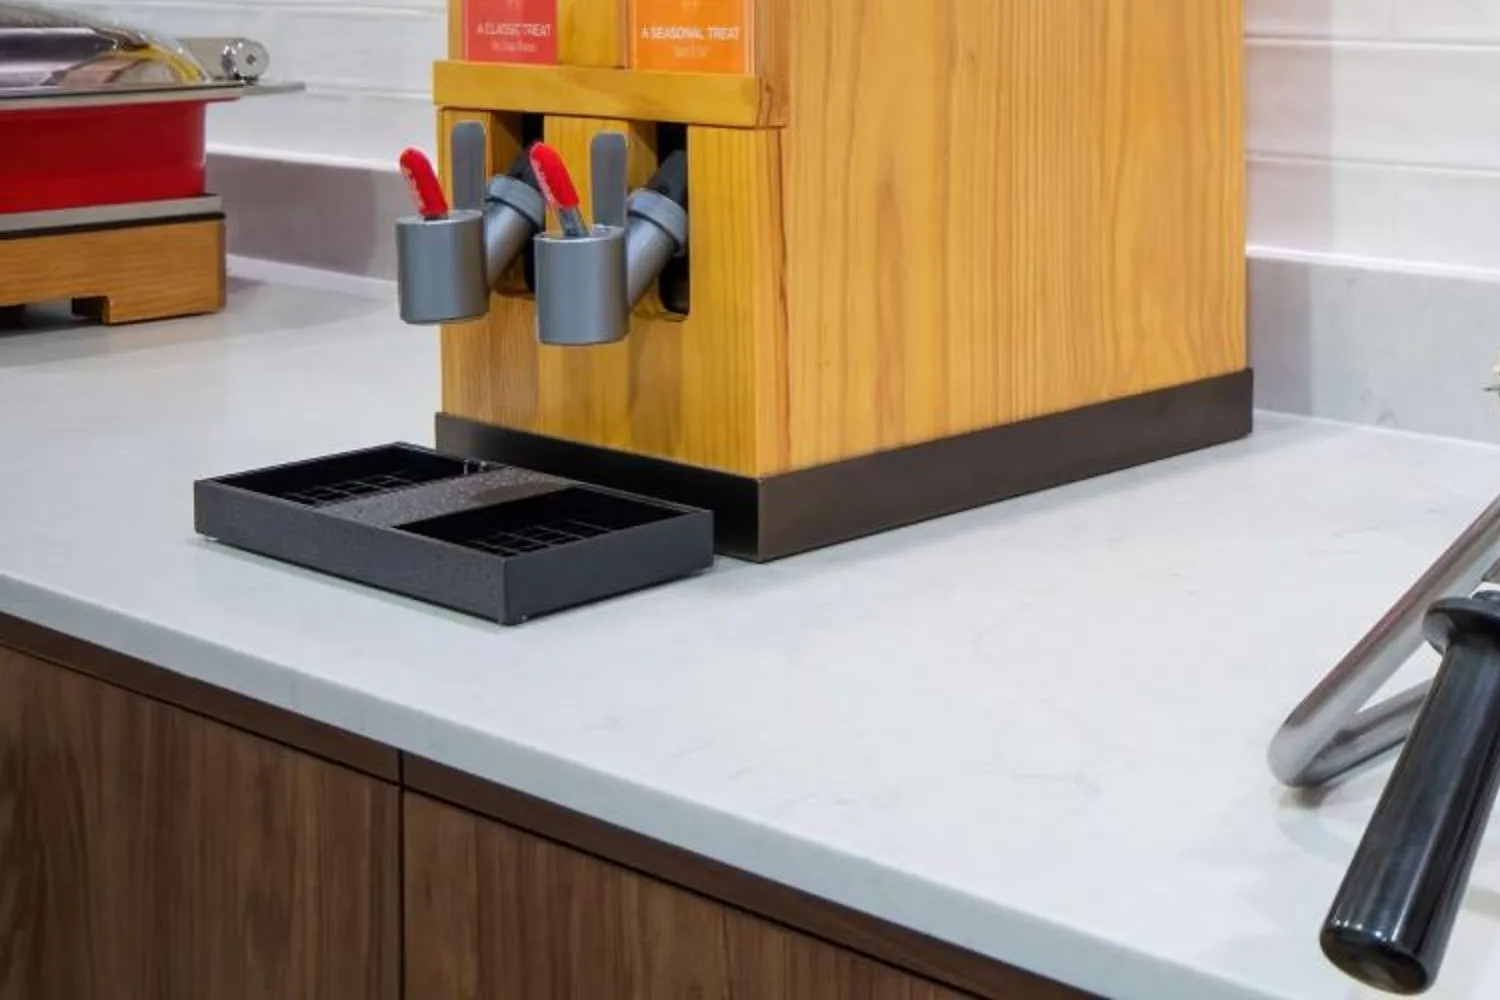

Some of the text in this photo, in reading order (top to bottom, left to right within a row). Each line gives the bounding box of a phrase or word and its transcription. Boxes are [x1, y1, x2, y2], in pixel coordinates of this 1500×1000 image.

[521, 23, 551, 38] TREAT
[640, 26, 648, 40] A
[708, 26, 739, 41] TREAT
